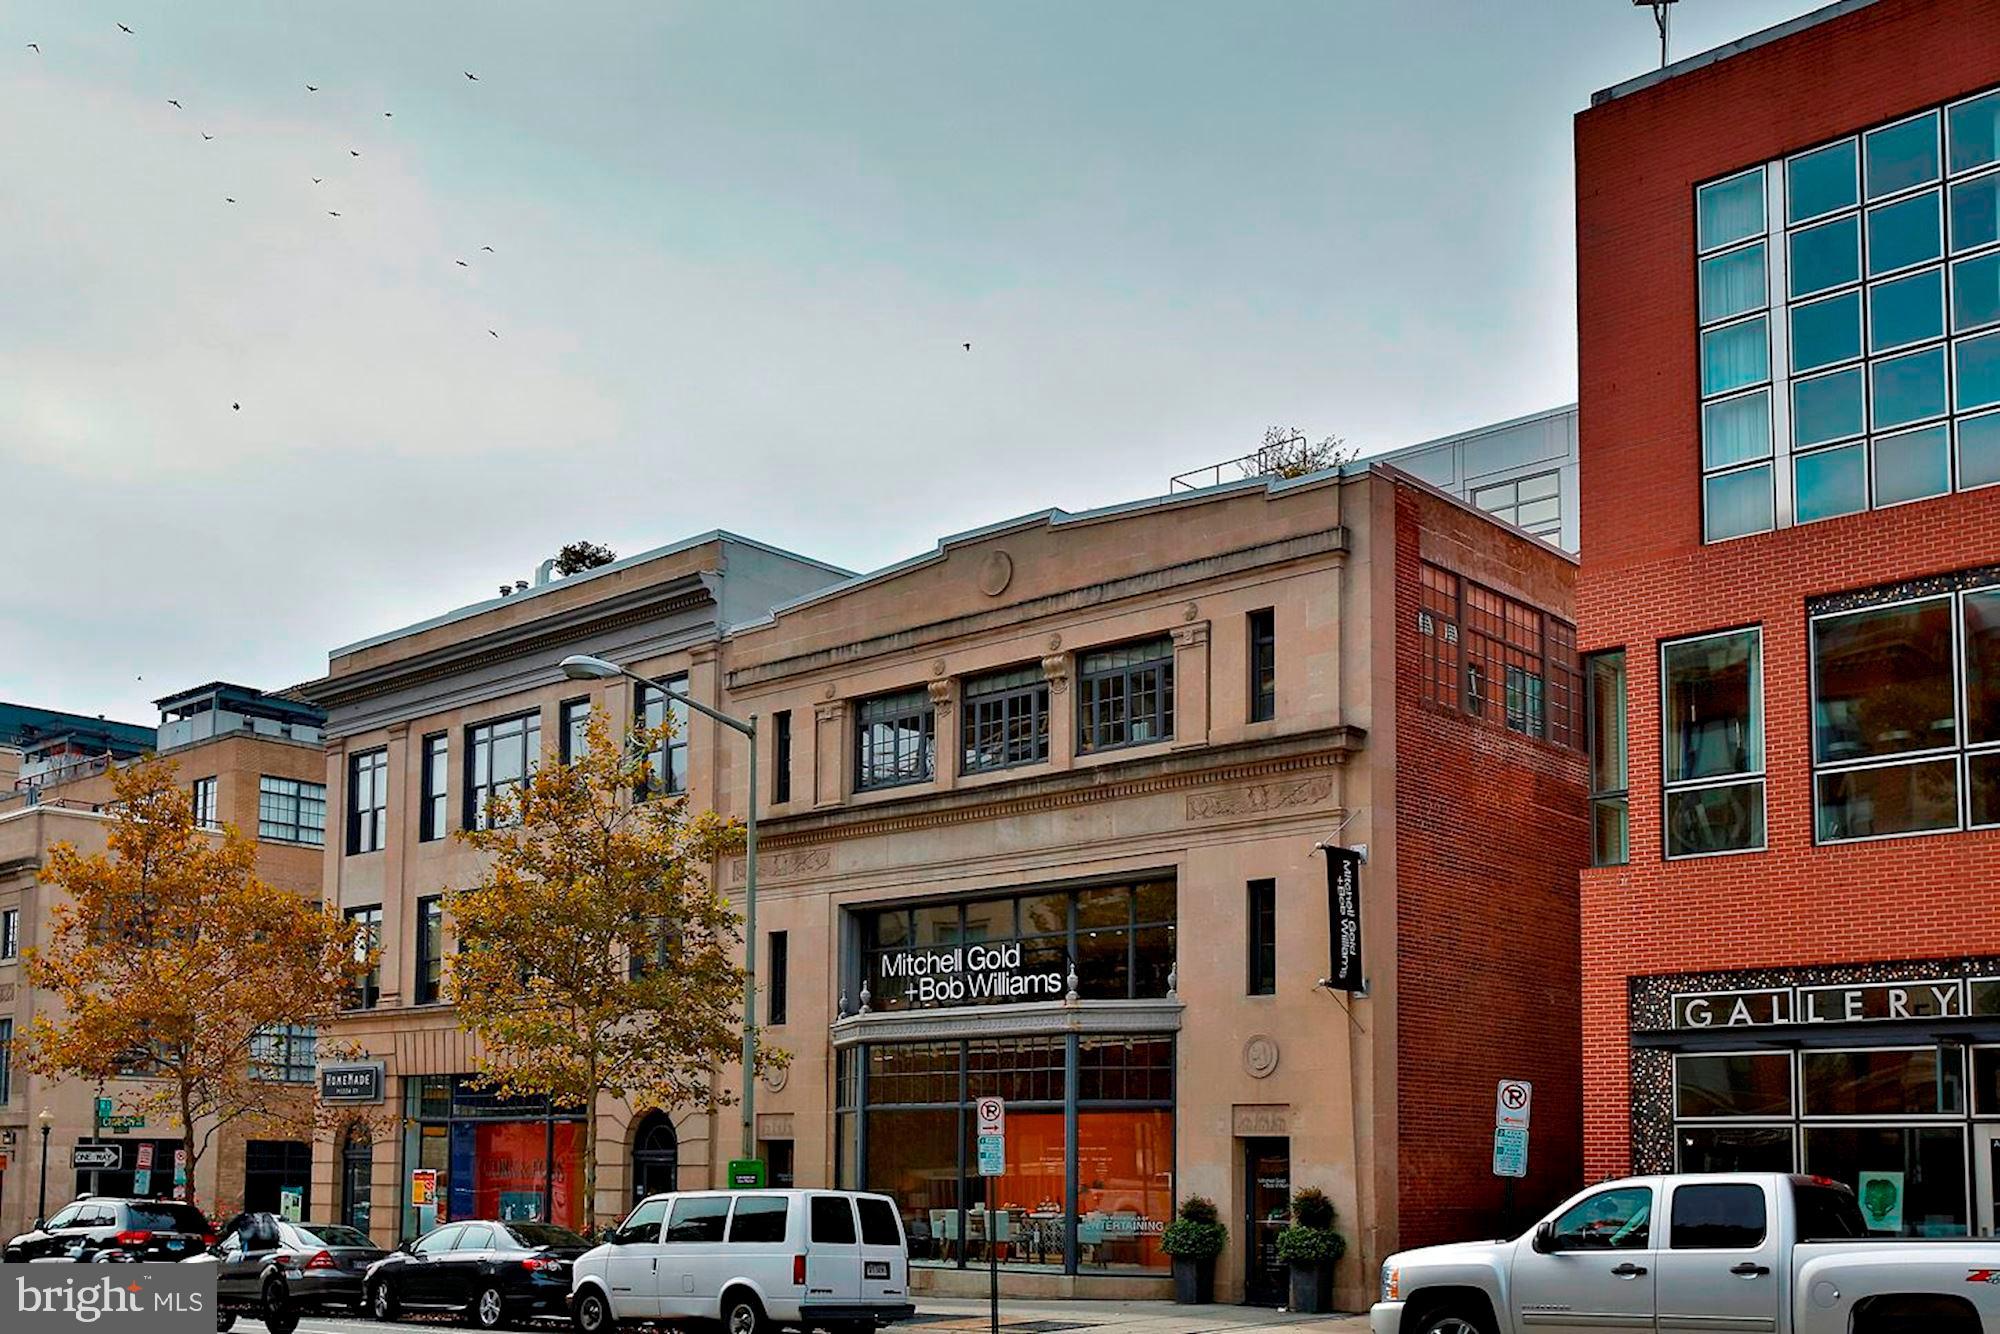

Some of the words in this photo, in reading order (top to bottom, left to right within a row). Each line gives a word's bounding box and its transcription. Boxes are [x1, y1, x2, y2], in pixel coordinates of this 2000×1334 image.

[1343, 859, 1355, 917] Mitchell
[1348, 920, 1357, 956] Gold
[881, 948, 962, 978] Mitchell
[967, 942, 1020, 971] Gold
[904, 975, 965, 1002] +Bob
[967, 971, 1062, 998] Williams
[1684, 986, 1957, 1027] GALLERY
